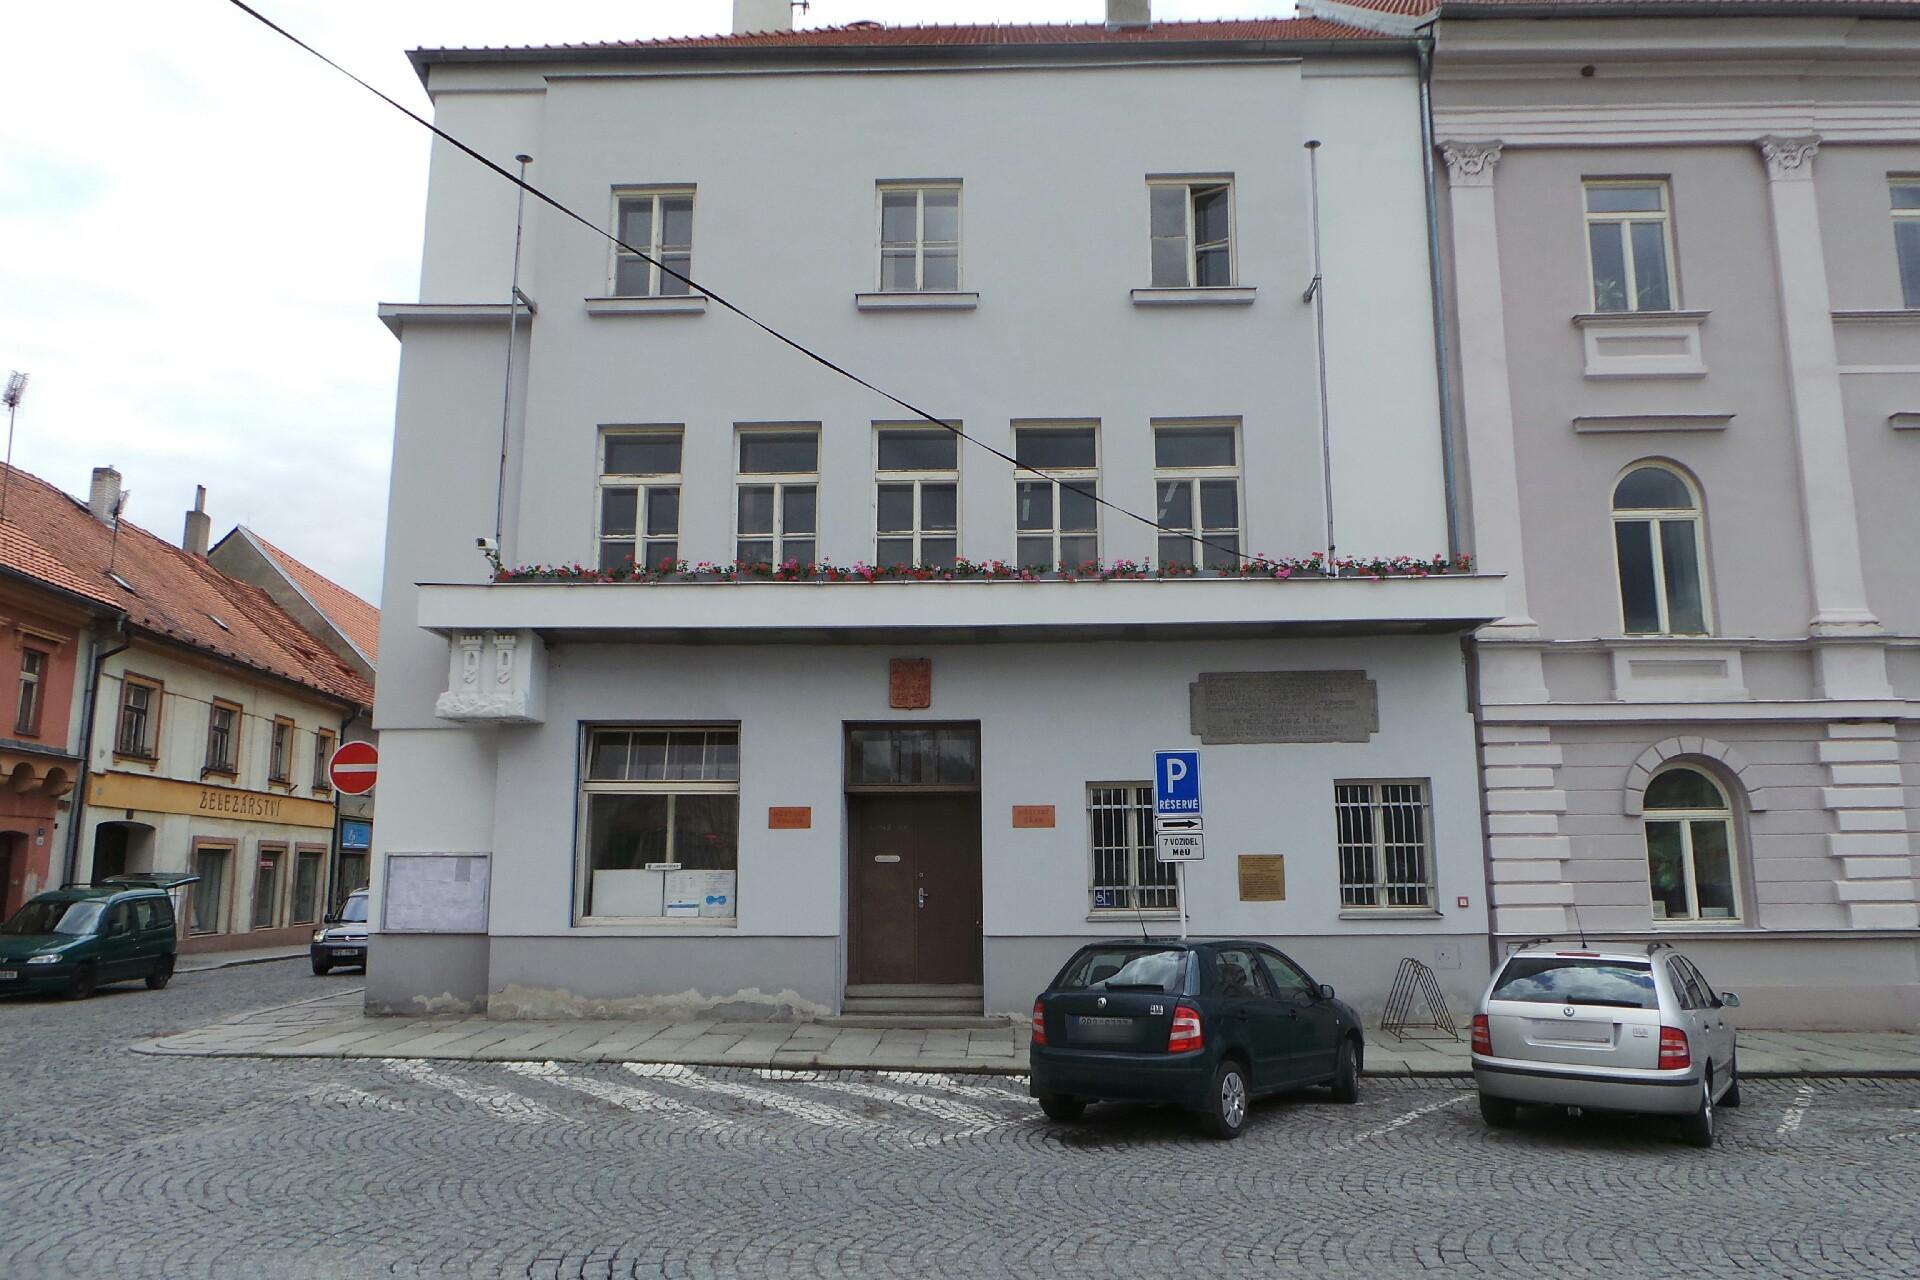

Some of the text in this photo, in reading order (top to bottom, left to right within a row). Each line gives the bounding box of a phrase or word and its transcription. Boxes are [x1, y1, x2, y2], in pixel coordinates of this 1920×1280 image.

[1166, 758, 1187, 793] P
[1163, 837, 1198, 846] 7 VOZIDEL
